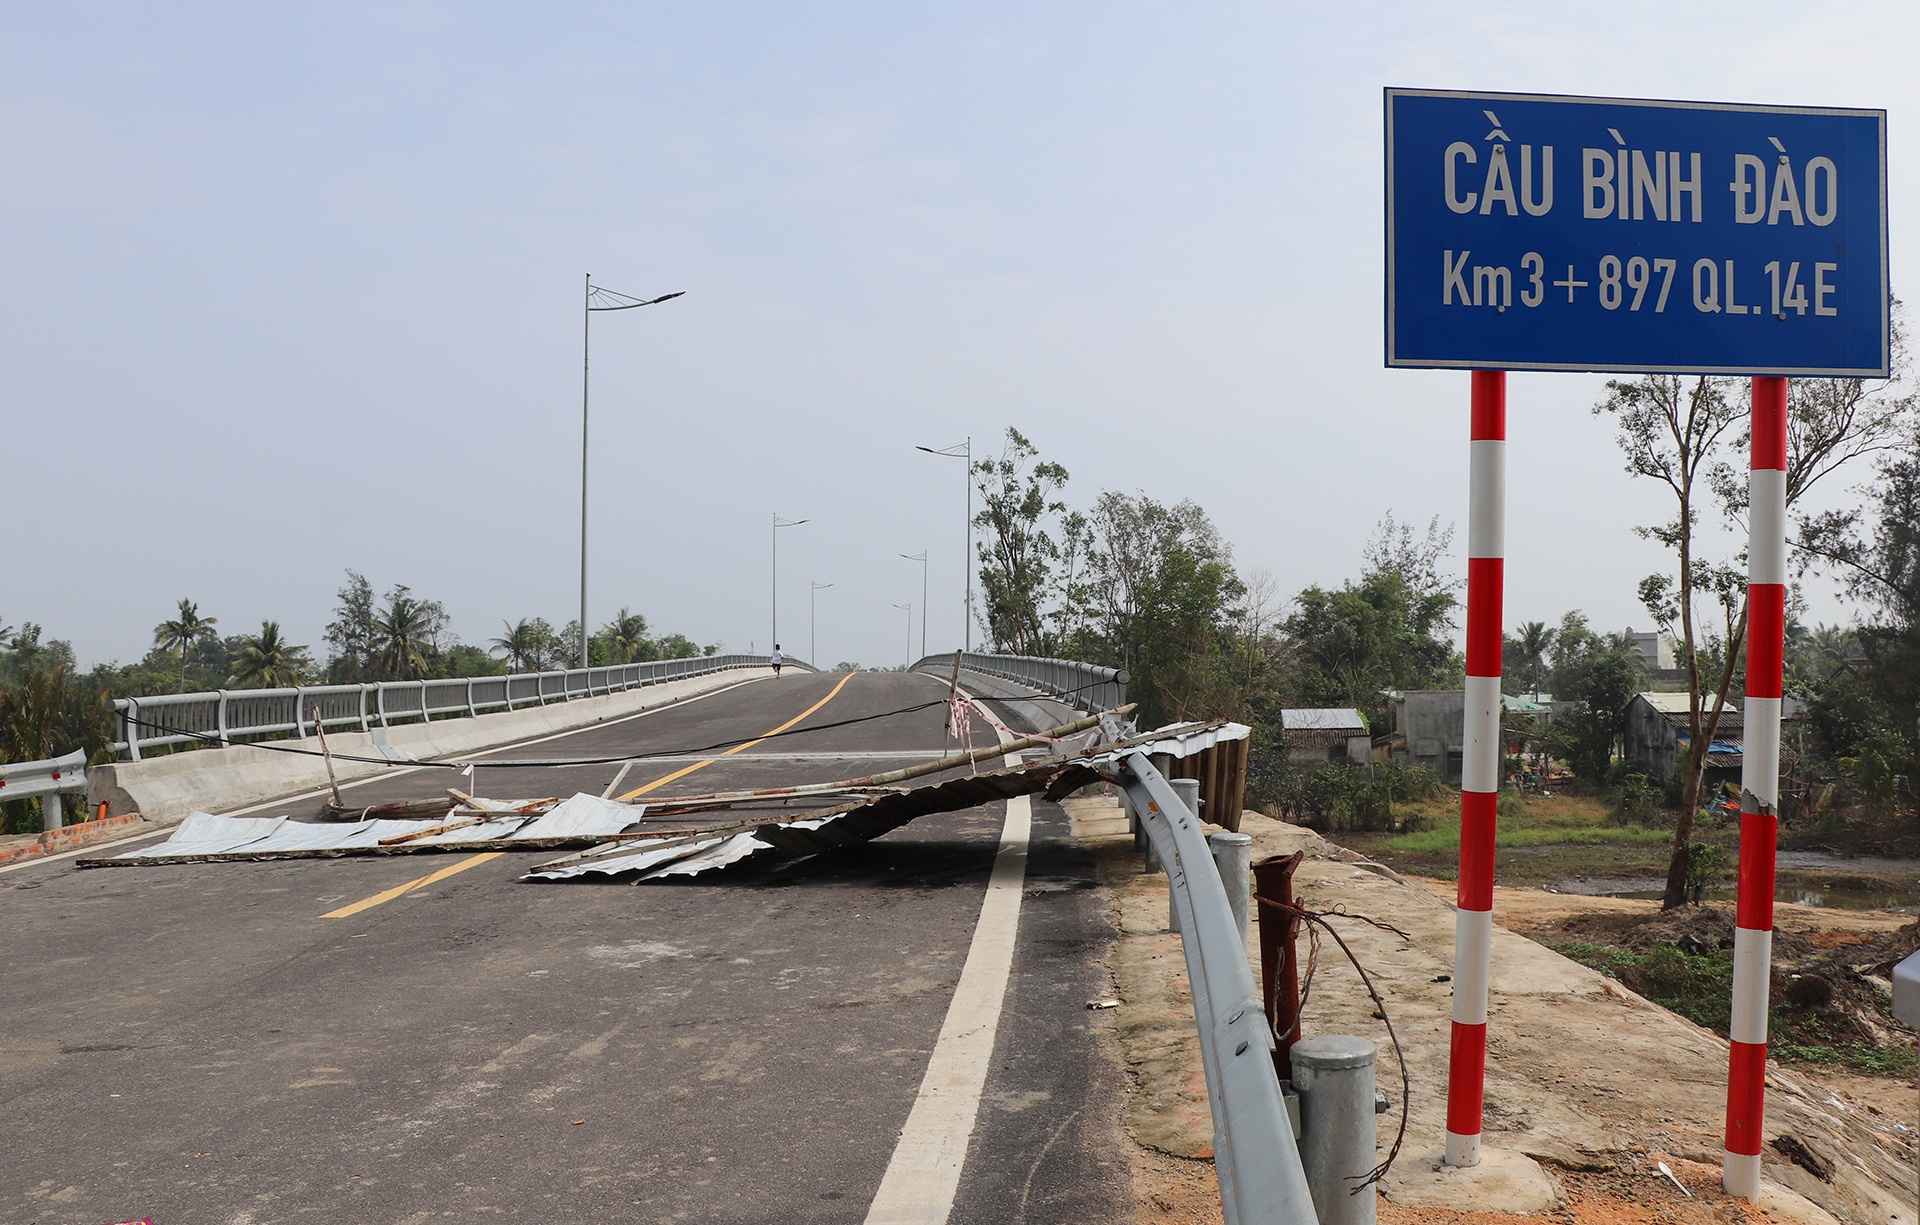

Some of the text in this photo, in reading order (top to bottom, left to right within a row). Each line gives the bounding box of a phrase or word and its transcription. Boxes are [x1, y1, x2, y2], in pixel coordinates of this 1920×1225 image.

[1444, 110, 1837, 227] CẦU BÌNH ĐÀO
[1693, 258, 1837, 316] QL.14E
